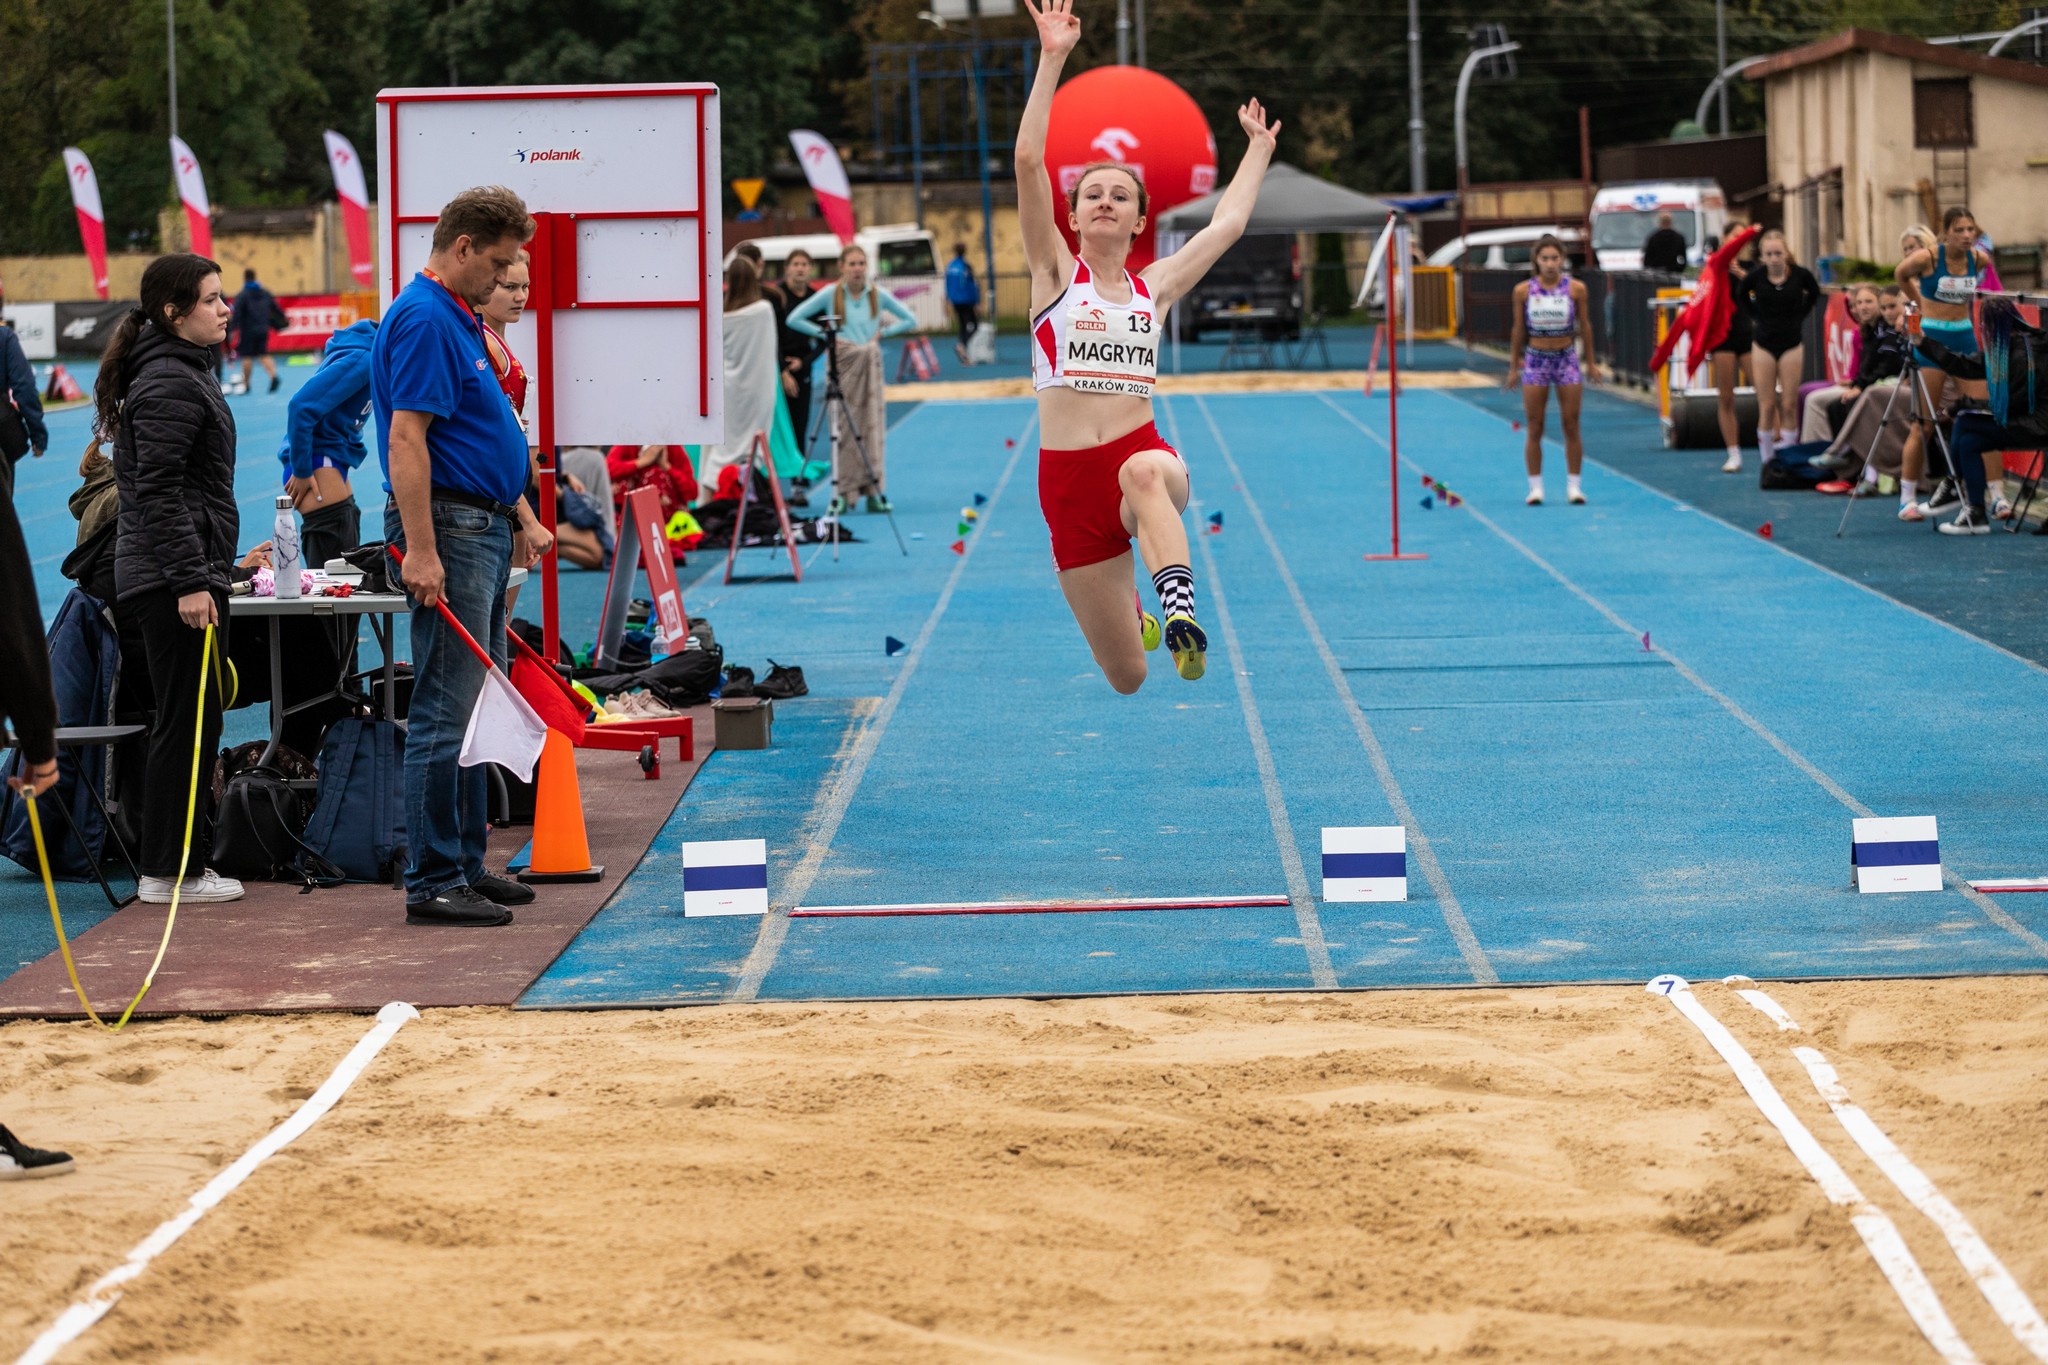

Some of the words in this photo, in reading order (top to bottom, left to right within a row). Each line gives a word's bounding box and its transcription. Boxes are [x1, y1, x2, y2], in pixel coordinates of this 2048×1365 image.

[530, 148, 581, 164] polanik
[1077, 322, 1106, 331] ORLEN
[1128, 314, 1151, 334] 13
[1068, 341, 1155, 368] MAGRYTA
[1074, 379, 1125, 392] KRAKÓW
[1127, 383, 1149, 395] 2022
[1658, 980, 1675, 995] 7
